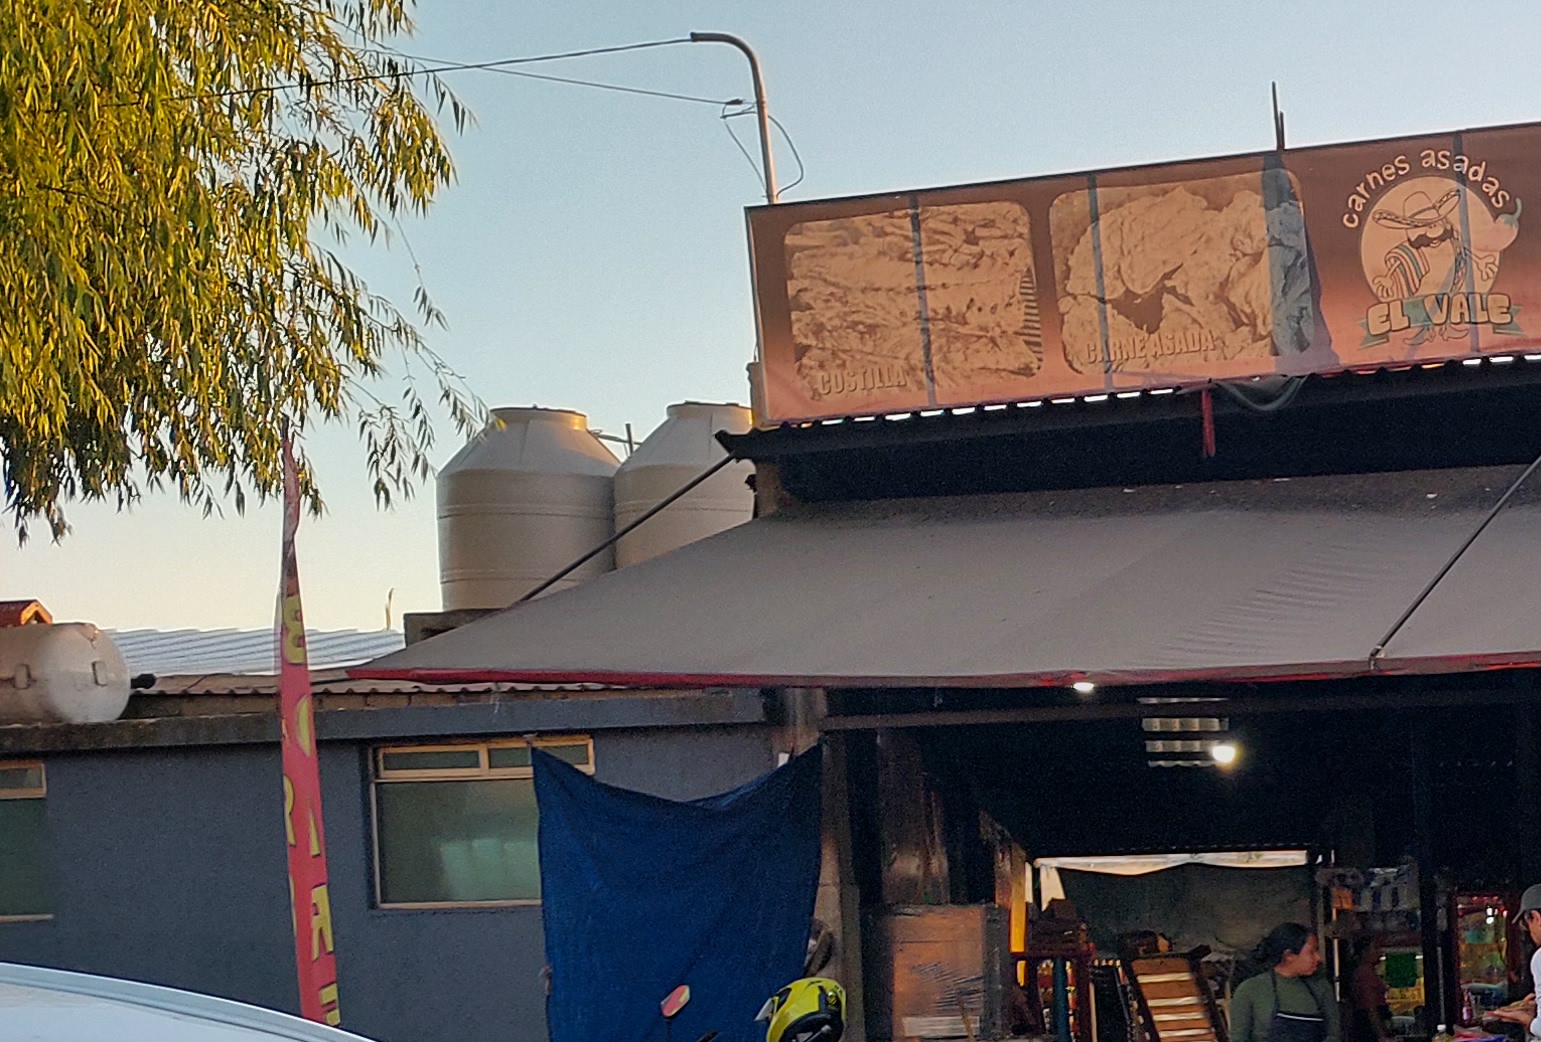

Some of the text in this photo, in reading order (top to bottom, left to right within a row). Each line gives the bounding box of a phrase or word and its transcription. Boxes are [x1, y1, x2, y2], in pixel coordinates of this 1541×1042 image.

[1342, 149, 1510, 229] carnes asadas
[1366, 292, 1513, 336] EL VALE
[1084, 334, 1148, 365] CARNE
